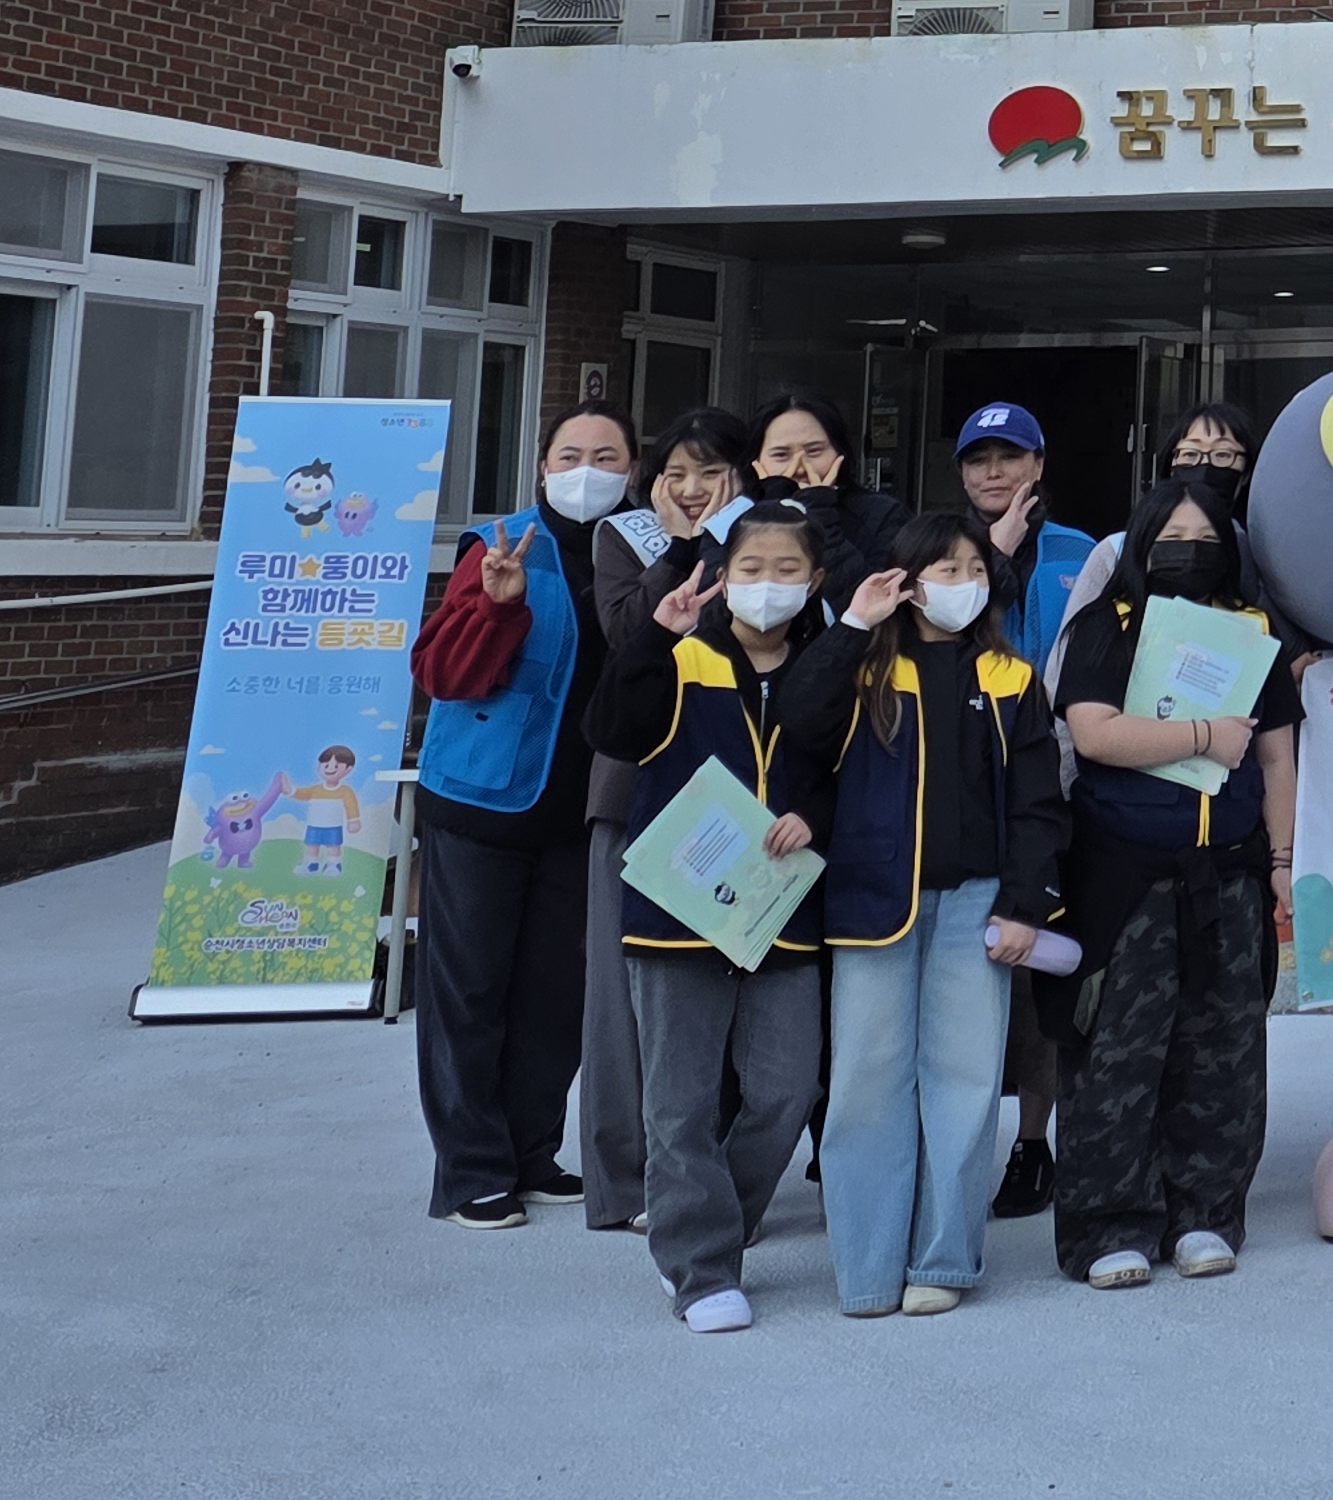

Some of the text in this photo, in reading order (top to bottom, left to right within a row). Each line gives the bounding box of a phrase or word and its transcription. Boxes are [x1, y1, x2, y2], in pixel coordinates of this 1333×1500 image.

[1110, 83, 1307, 160] 꿈꾸는
[261, 587, 376, 614] 함께하는
[222, 620, 310, 647] 신나는
[225, 675, 382, 695] 소중한 너를 응원해
